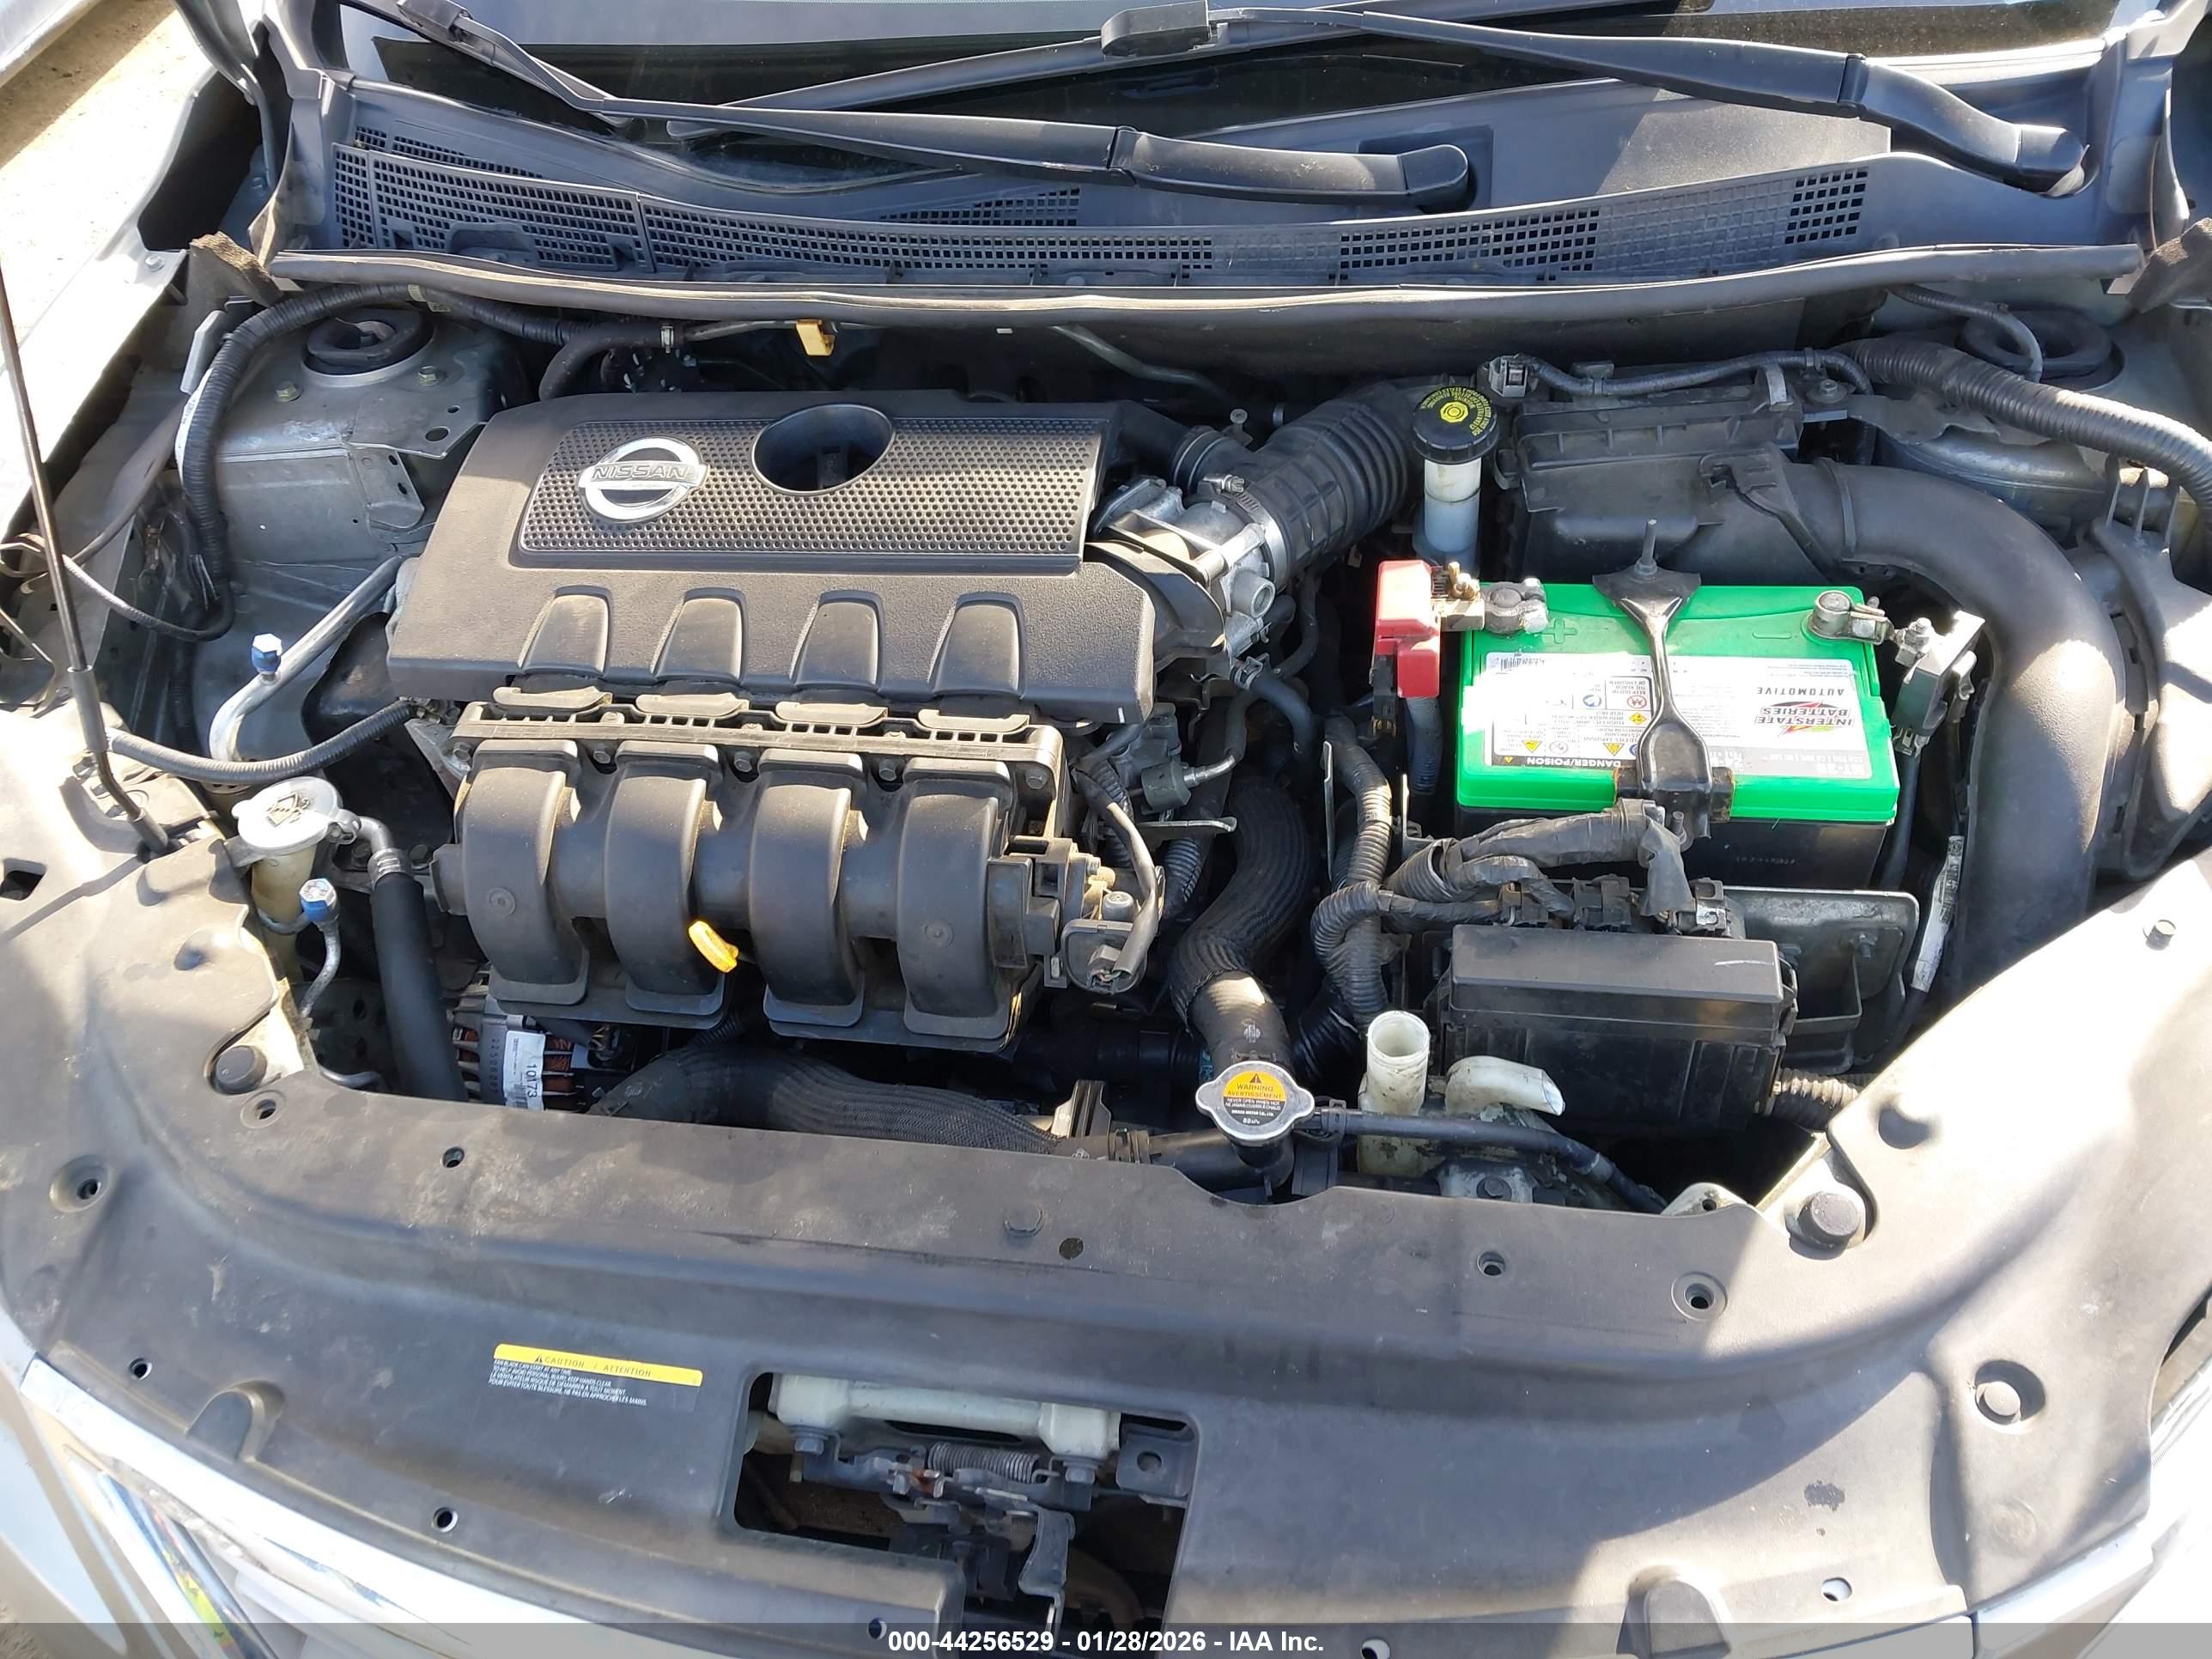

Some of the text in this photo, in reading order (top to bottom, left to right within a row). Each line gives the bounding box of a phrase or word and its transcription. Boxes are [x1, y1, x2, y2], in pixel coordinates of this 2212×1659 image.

[592, 465, 689, 481] NISSAN
[1756, 686, 1845, 696] AUTOMOTIVE
[1761, 707, 1849, 717] BATTERIES
[1757, 715, 1853, 726] INTERSTATE
[1526, 757, 1621, 768] DANGER/POISON
[526, 1064, 538, 1098] 10173
[1237, 1083, 1273, 1092] WARNING
[1227, 1089, 1281, 1099] AVERTISSEMENT
[544, 1356, 584, 1367] CAUTION
[603, 1364, 651, 1376] ATTENTION
[488, 1377, 502, 1386] POUR
[520, 1382, 537, 1390] TOUTE
[579, 1376, 596, 1384] HANDS
